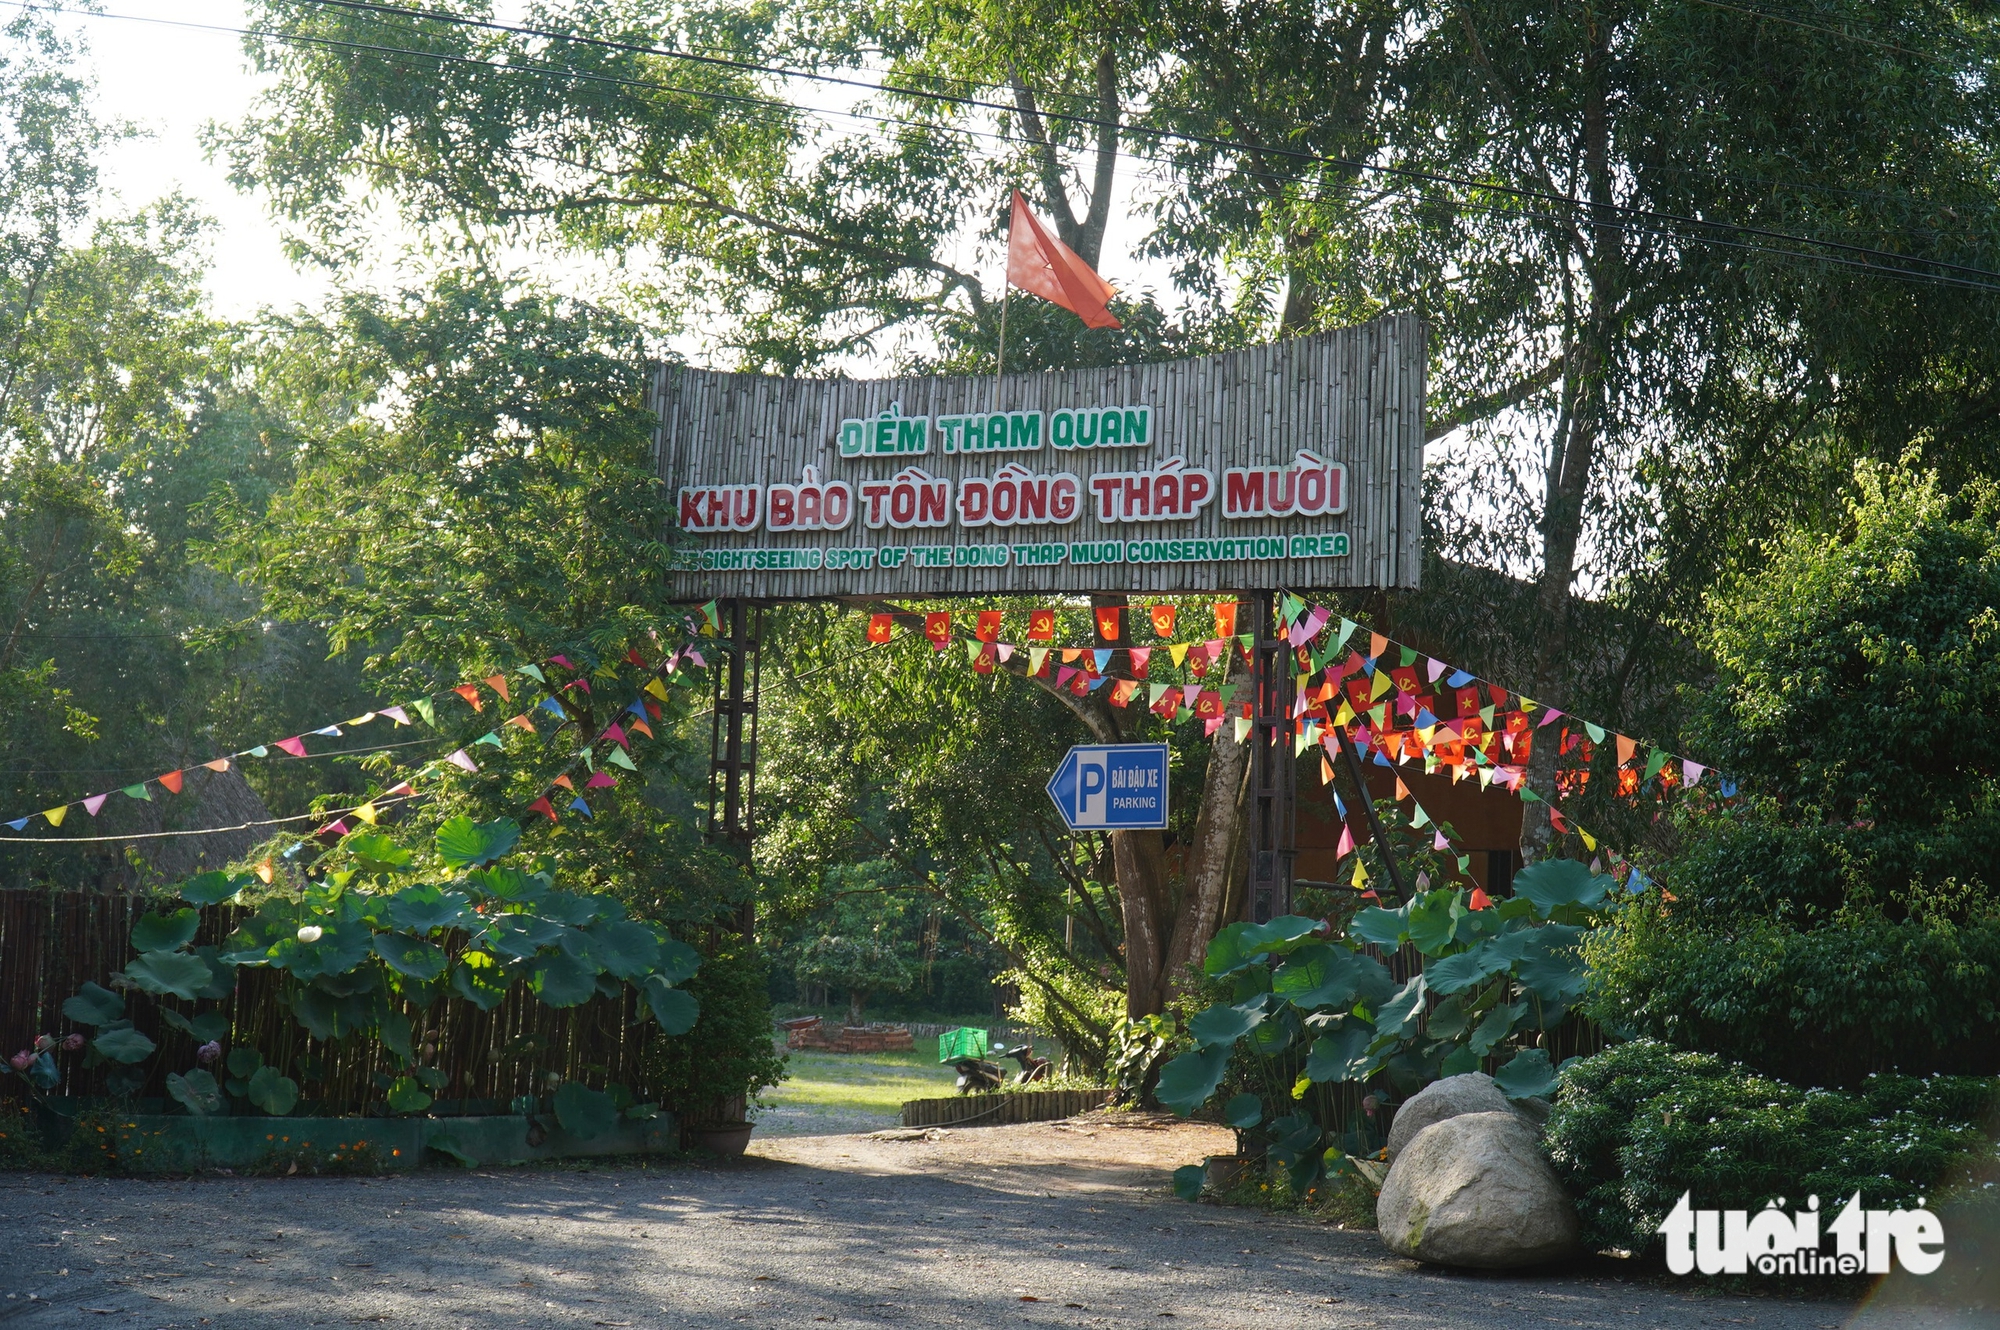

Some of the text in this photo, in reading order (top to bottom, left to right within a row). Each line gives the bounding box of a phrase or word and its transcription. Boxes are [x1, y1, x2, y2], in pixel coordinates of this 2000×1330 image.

[839, 404, 1149, 456] ĐIỂM THAM QUAN
[678, 451, 1343, 529] KHU BẢO TỒN ĐỒNG THÁP MƯỜI
[702, 549, 821, 570] SIGHTSEEING
[825, 549, 876, 570] SPOT
[880, 547, 907, 568] OF
[911, 547, 951, 567] THE
[954, 546, 1008, 567] DONG
[1013, 544, 1067, 564] THAP
[1071, 541, 1122, 563] MUOI
[1127, 537, 1285, 562] CONSERVATION
[1290, 534, 1348, 557] AREA
[1080, 763, 1105, 812] P
[1111, 765, 1158, 792] BÃI ĐẬU XE
[1113, 796, 1156, 809] PARKING
